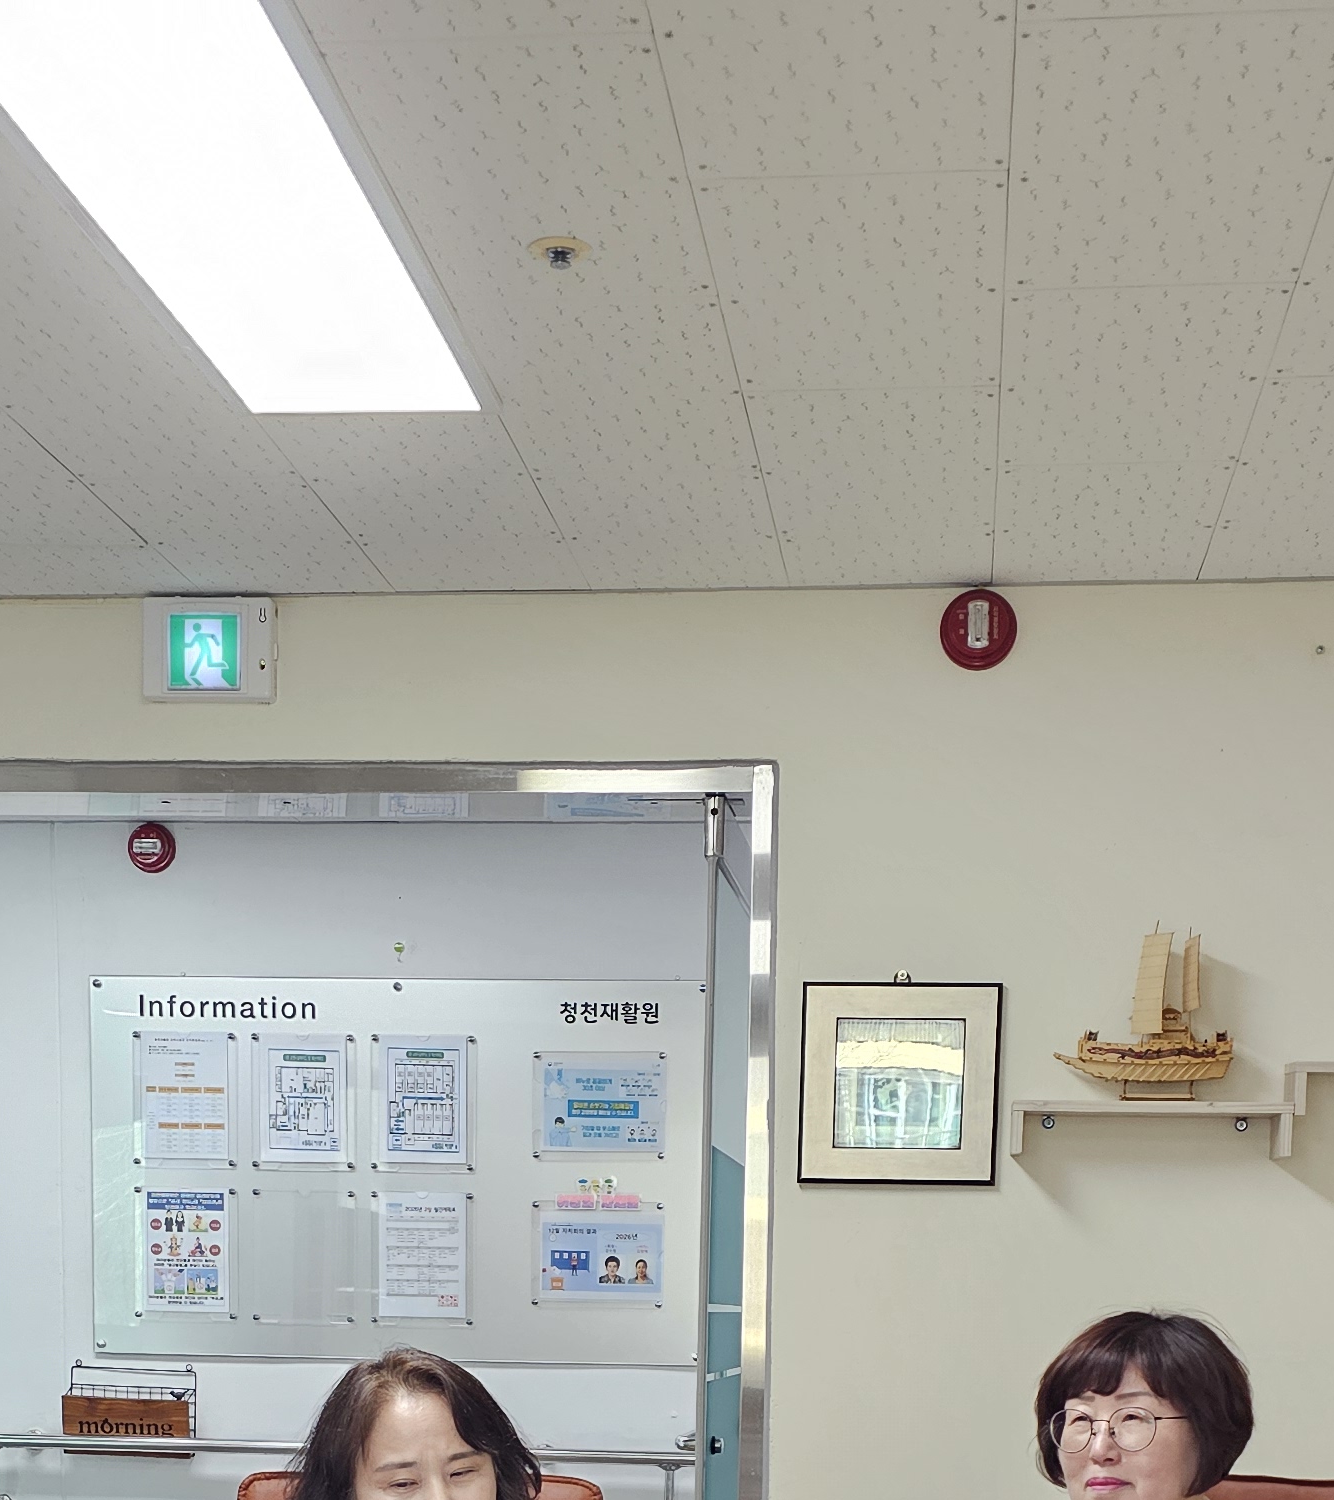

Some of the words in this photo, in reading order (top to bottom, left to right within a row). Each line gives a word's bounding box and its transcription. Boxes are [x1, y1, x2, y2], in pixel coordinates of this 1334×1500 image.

[138, 995, 318, 1020] Information
[559, 1001, 660, 1025] 청천재활원
[615, 1233, 638, 1241] 2026년
[78, 1418, 175, 1438] morning
